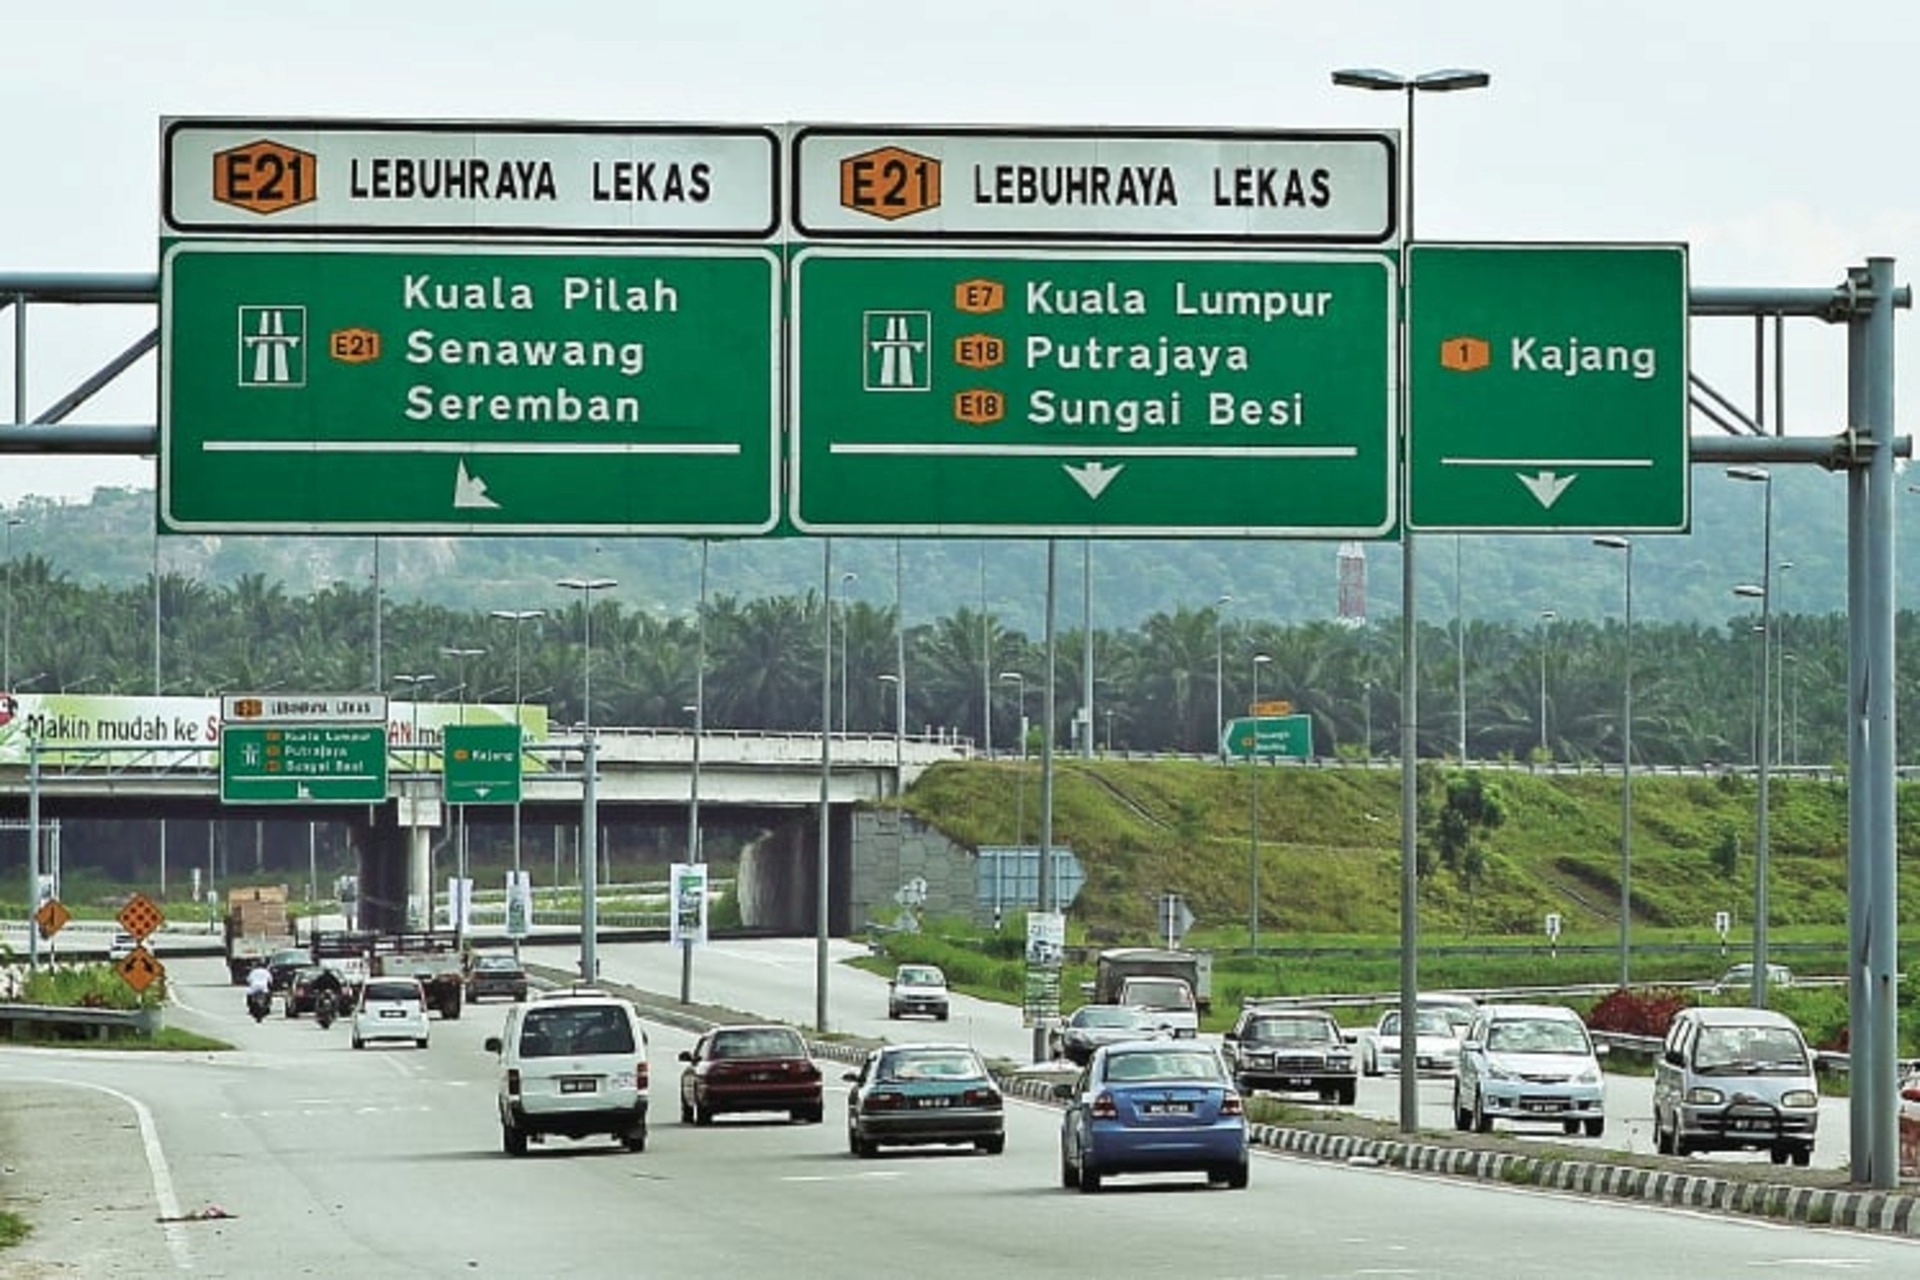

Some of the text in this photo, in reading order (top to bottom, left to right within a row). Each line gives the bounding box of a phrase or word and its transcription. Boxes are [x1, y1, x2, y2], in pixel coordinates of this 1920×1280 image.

[227, 154, 711, 203] E21 LEBUHRAYA LEKAS
[852, 159, 1331, 208] E21 LEBUHRAYA LEKAS
[404, 275, 678, 312] Kuala Pilah
[966, 287, 993, 307] E7
[1026, 281, 1332, 322] Kuala Lumpur
[335, 335, 375, 356] E21
[406, 329, 644, 375] Senawang
[960, 340, 999, 362] E18
[1026, 336, 1249, 377] Putrajaya
[1511, 336, 1656, 378] Kajang
[405, 385, 640, 423] Seremban
[960, 395, 998, 417] E18
[1027, 390, 1302, 433] Sungai Besi
[26, 714, 90, 741] Makin
[97, 716, 168, 741] mudah
[174, 717, 198, 741] ke
